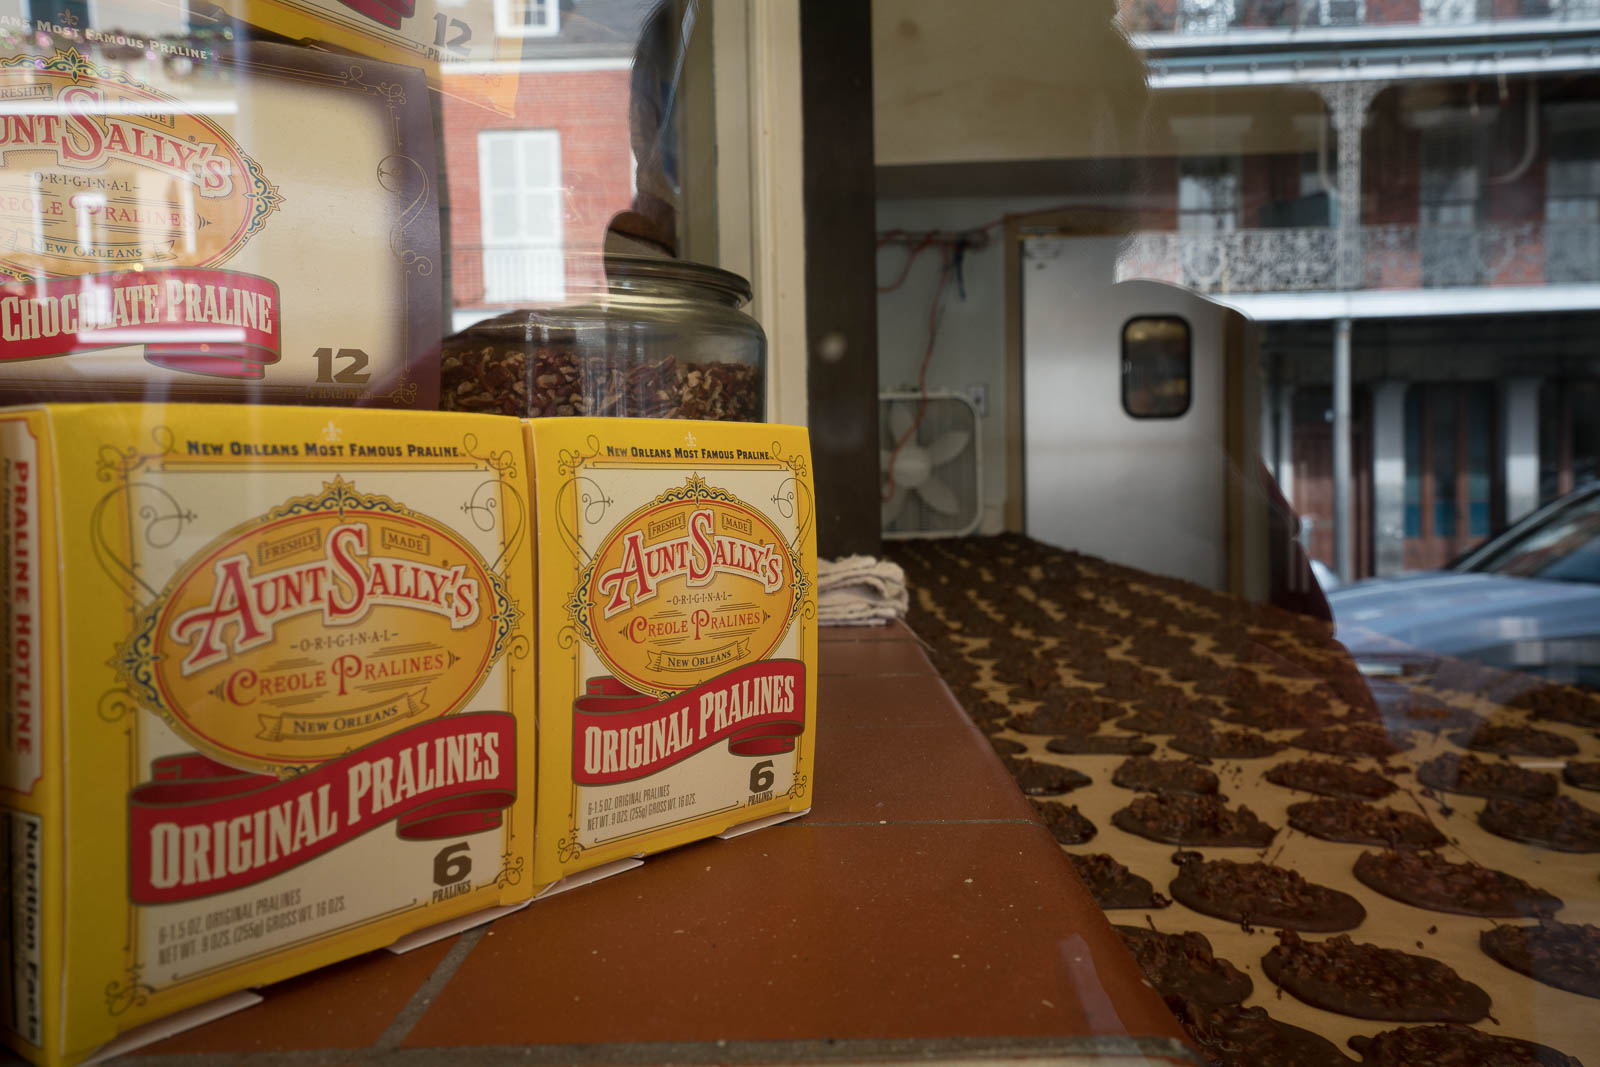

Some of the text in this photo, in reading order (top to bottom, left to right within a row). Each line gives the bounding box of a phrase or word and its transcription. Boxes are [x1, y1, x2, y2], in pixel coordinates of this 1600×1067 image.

[37, 19, 80, 38] MOST
[85, 28, 144, 48] FAMOUS
[150, 40, 208, 60] PRALINE
[433, 12, 472, 56] 12
[62, 87, 225, 189] SALLY'S
[73, 245, 143, 258] ORLEANS
[165, 279, 272, 334] PRALINE
[312, 347, 372, 384] 12
[187, 441, 458, 457] NEW ORLEANS MOST FAMOUS PRALINE
[606, 446, 769, 460] NEW ORLEANS MOST FAMOUS PRALINE
[388, 534, 424, 551] MADE
[652, 516, 682, 534] FRESHLY
[726, 517, 748, 532] MADE
[263, 533, 316, 558] FRESHLY
[601, 512, 779, 611] AUNT SALLY'S
[14, 461, 32, 754] PRALINE HOTLINE
[175, 527, 473, 666] AUNT SALLY'S
[629, 609, 761, 644] CREOLE PRALINES
[667, 650, 731, 668] NEW ORLEANS
[226, 651, 444, 706] CREOLE PRALINES
[293, 705, 398, 734] NEW ORLEANS
[584, 675, 795, 774] ORIGINAL PRALINES
[749, 759, 775, 793] 6
[150, 732, 500, 889] ORIGINAL PRALINES
[587, 816, 599, 831] NET
[648, 800, 667, 816] GROSS
[678, 796, 685, 808] 16
[614, 791, 642, 809] ORIGINAL
[643, 784, 670, 801] PRALINES
[748, 791, 773, 807] PRALINES
[433, 841, 472, 887] 6
[206, 902, 254, 931] ORIGINAL
[256, 888, 302, 916] PRALINES
[432, 880, 471, 903] PRALINES
[26, 821, 38, 1042] Nutrition Facts
[158, 946, 178, 966] NET
[265, 910, 296, 933] GROSS
[316, 902, 327, 918] 16
